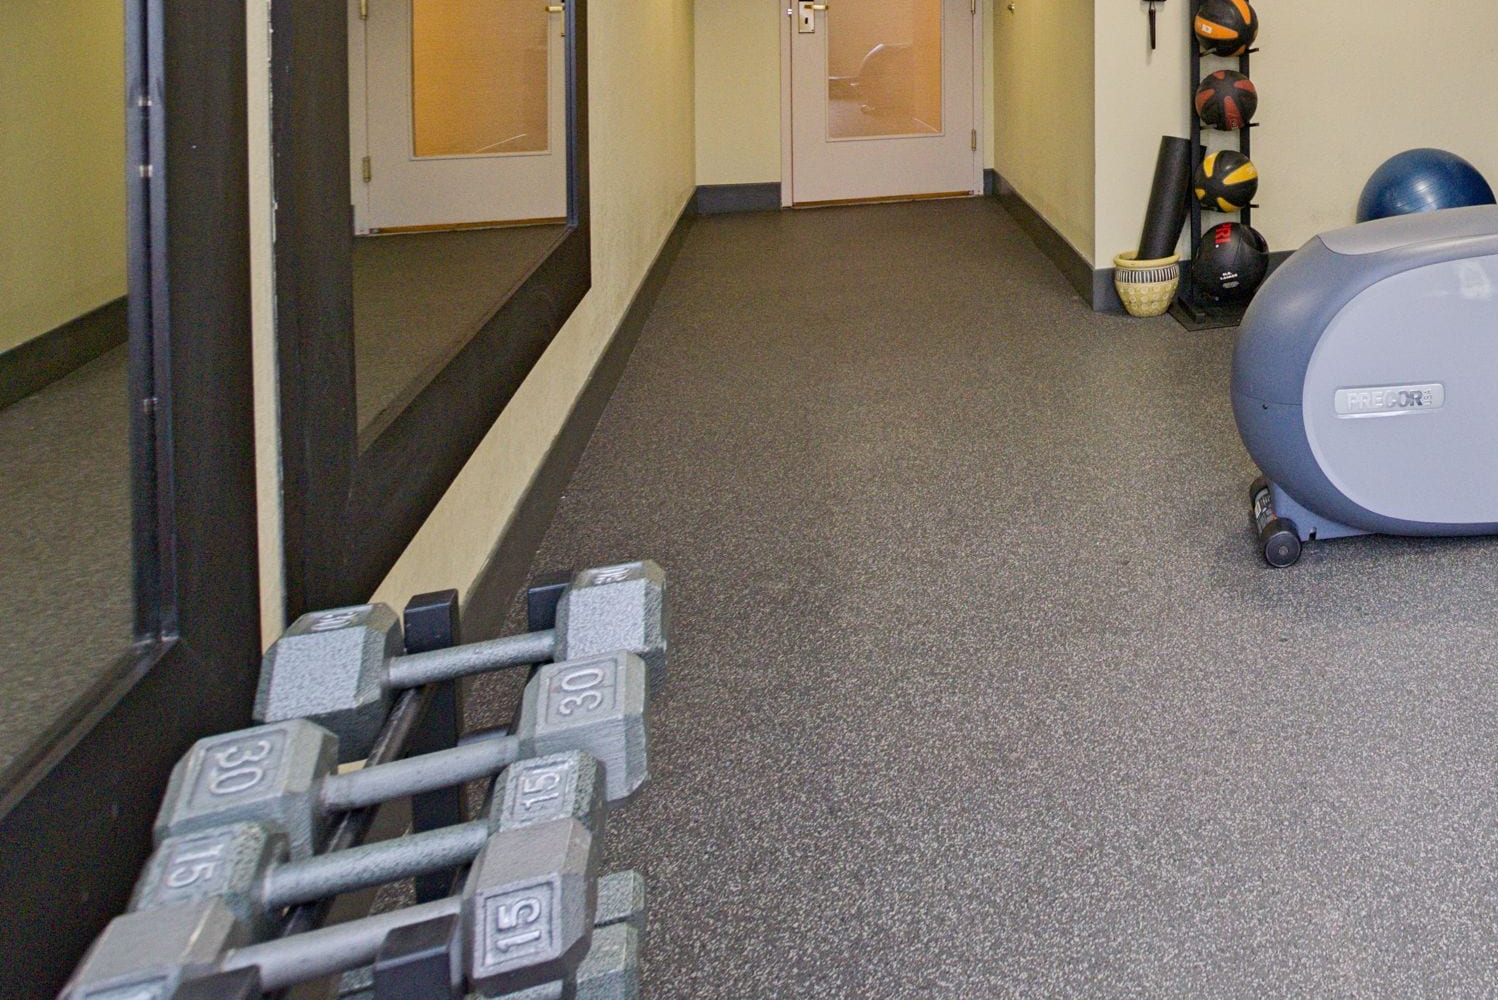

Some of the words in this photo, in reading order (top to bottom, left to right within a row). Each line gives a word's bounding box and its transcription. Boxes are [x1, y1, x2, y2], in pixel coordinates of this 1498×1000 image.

[1346, 390, 1423, 410] PRECOR
[560, 667, 604, 715] 30
[208, 740, 272, 795] 30
[521, 772, 561, 812] 15
[166, 844, 225, 889] 15
[496, 896, 542, 953] 15
